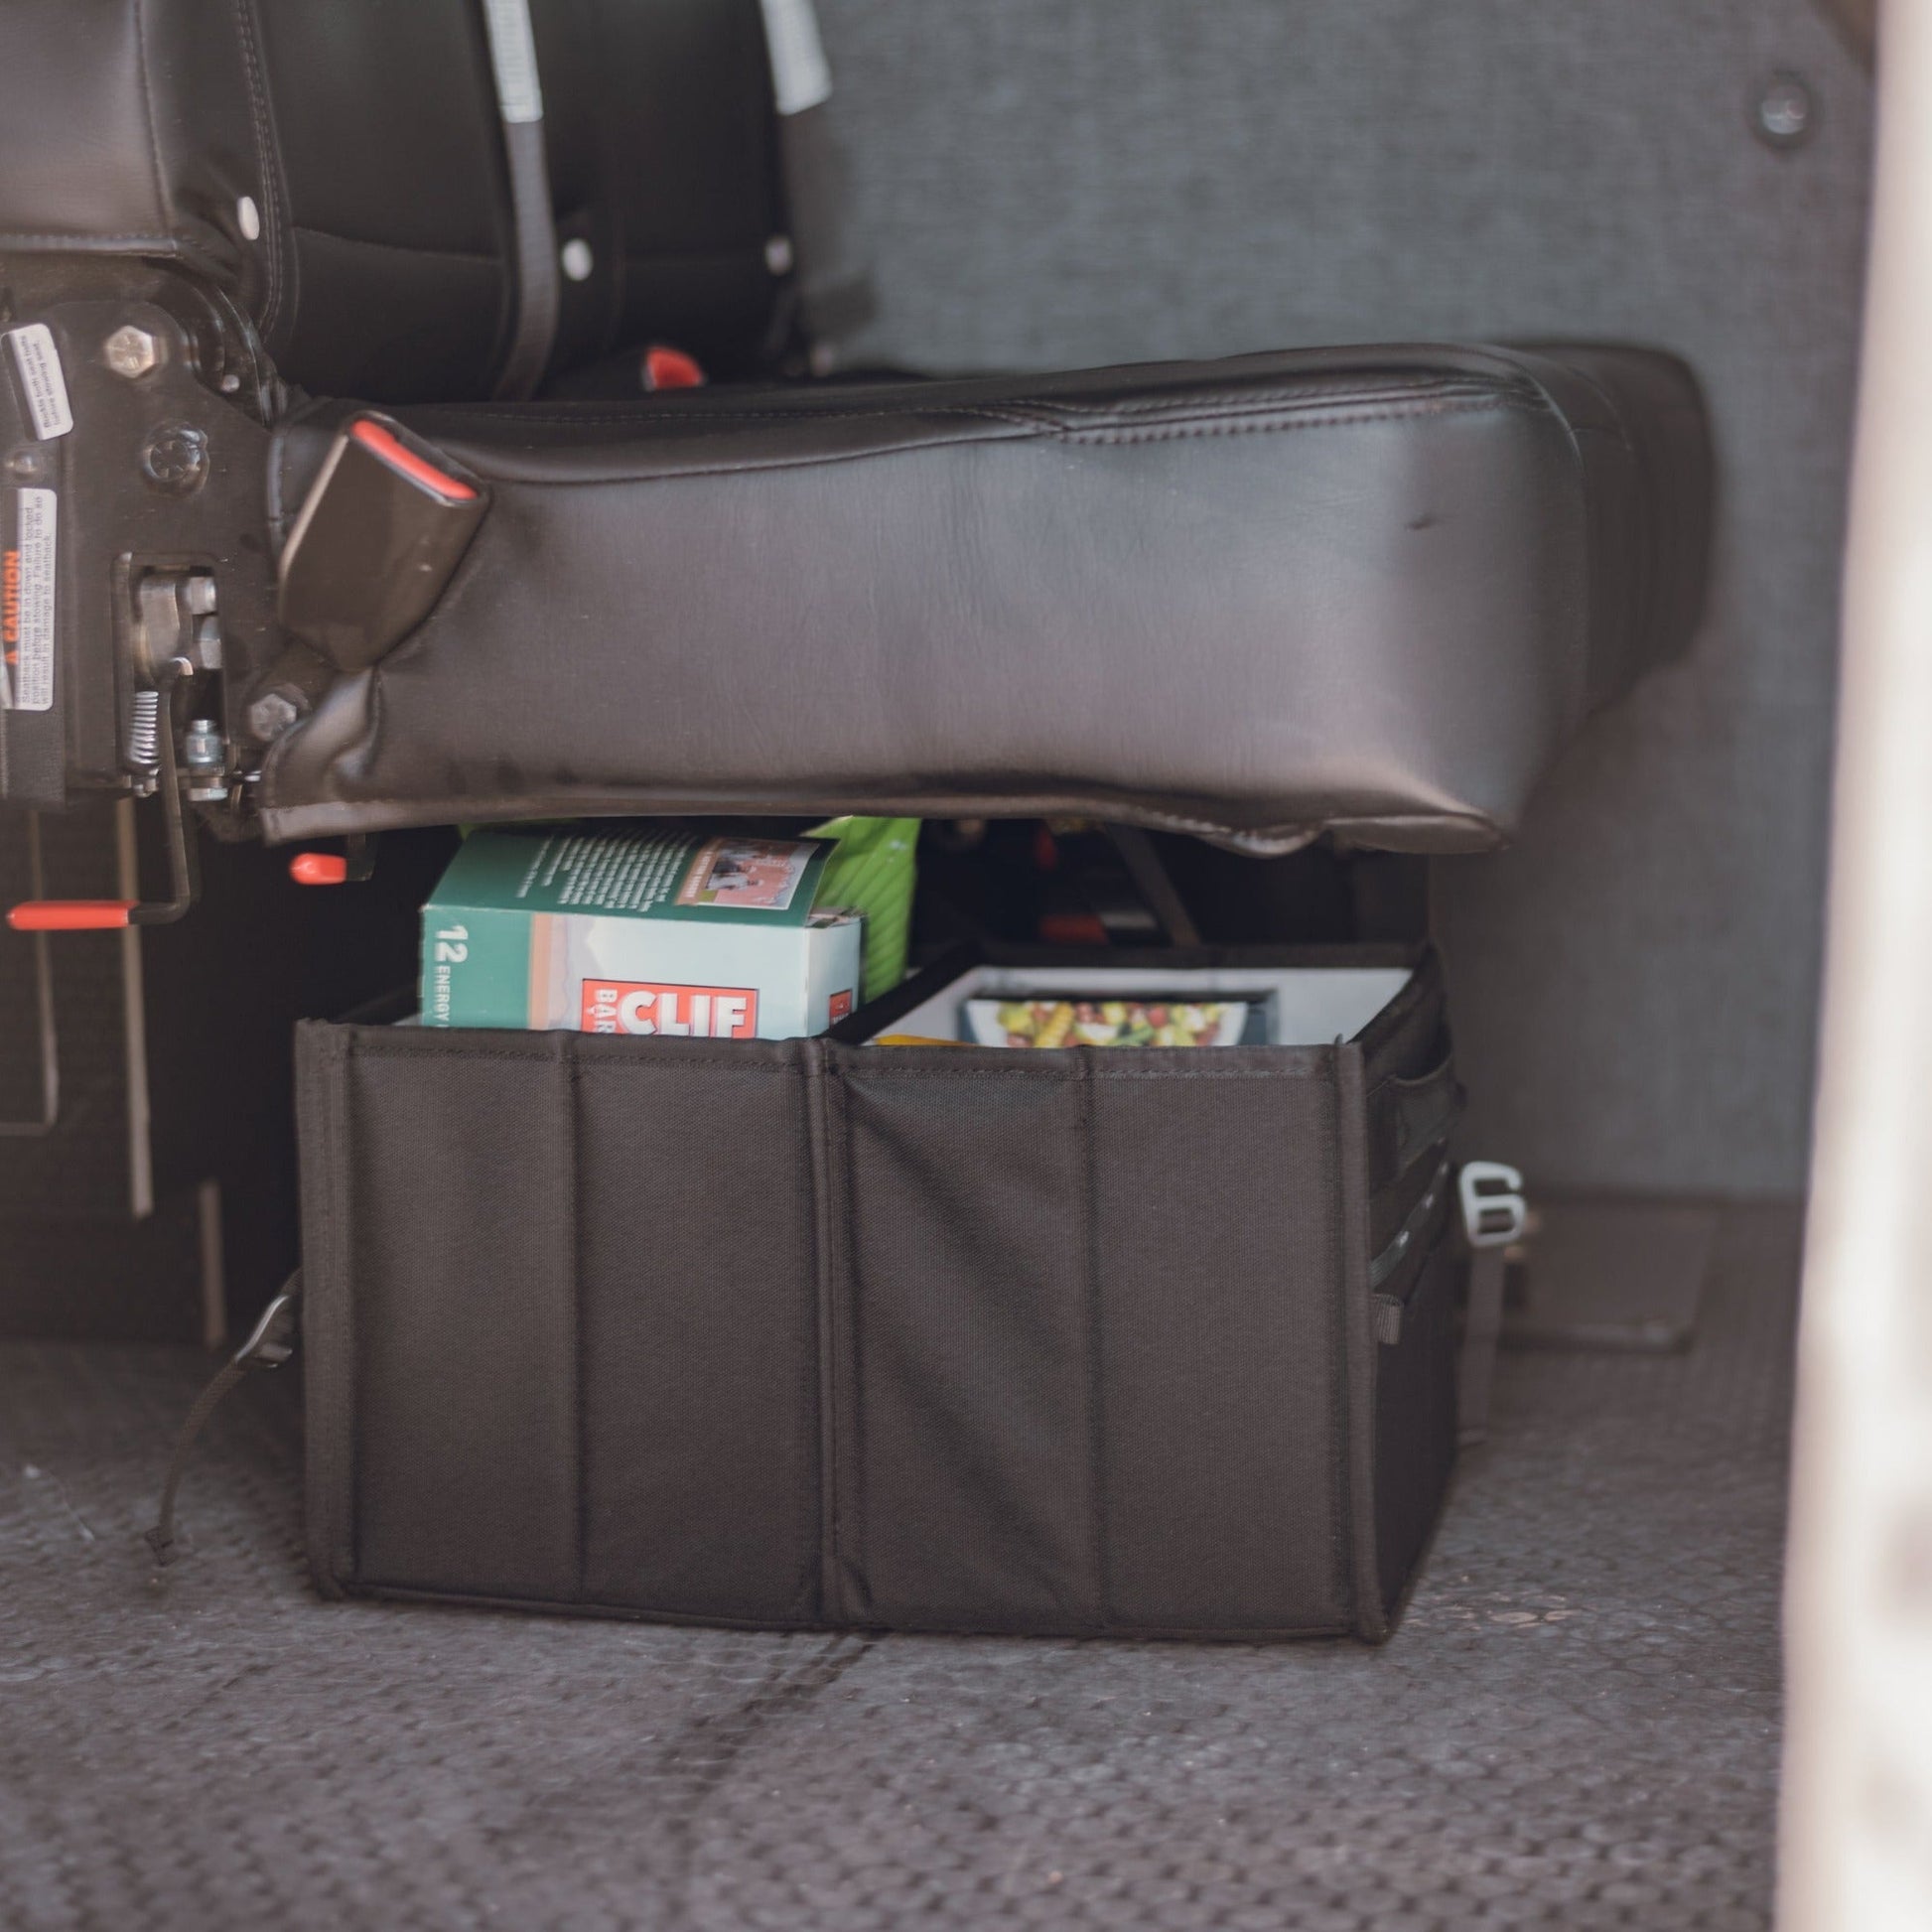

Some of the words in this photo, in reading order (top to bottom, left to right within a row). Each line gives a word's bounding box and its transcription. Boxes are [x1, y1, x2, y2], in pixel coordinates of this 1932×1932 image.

[24, 507, 33, 541] locked
[23, 544, 32, 563] and
[33, 543, 42, 578] Failure
[2, 550, 20, 642] CAUTION
[23, 568, 32, 595] down
[22, 611, 31, 623] be
[42, 599, 52, 640] damage
[22, 626, 31, 652] must
[32, 627, 41, 660] before
[22, 655, 31, 703] Seatback
[32, 663, 41, 704] position
[41, 656, 50, 684] result
[434, 925, 469, 963] 12
[433, 966, 451, 1022] ENERGY
[588, 989, 618, 1034] BAR
[619, 990, 747, 1037] CLIF
